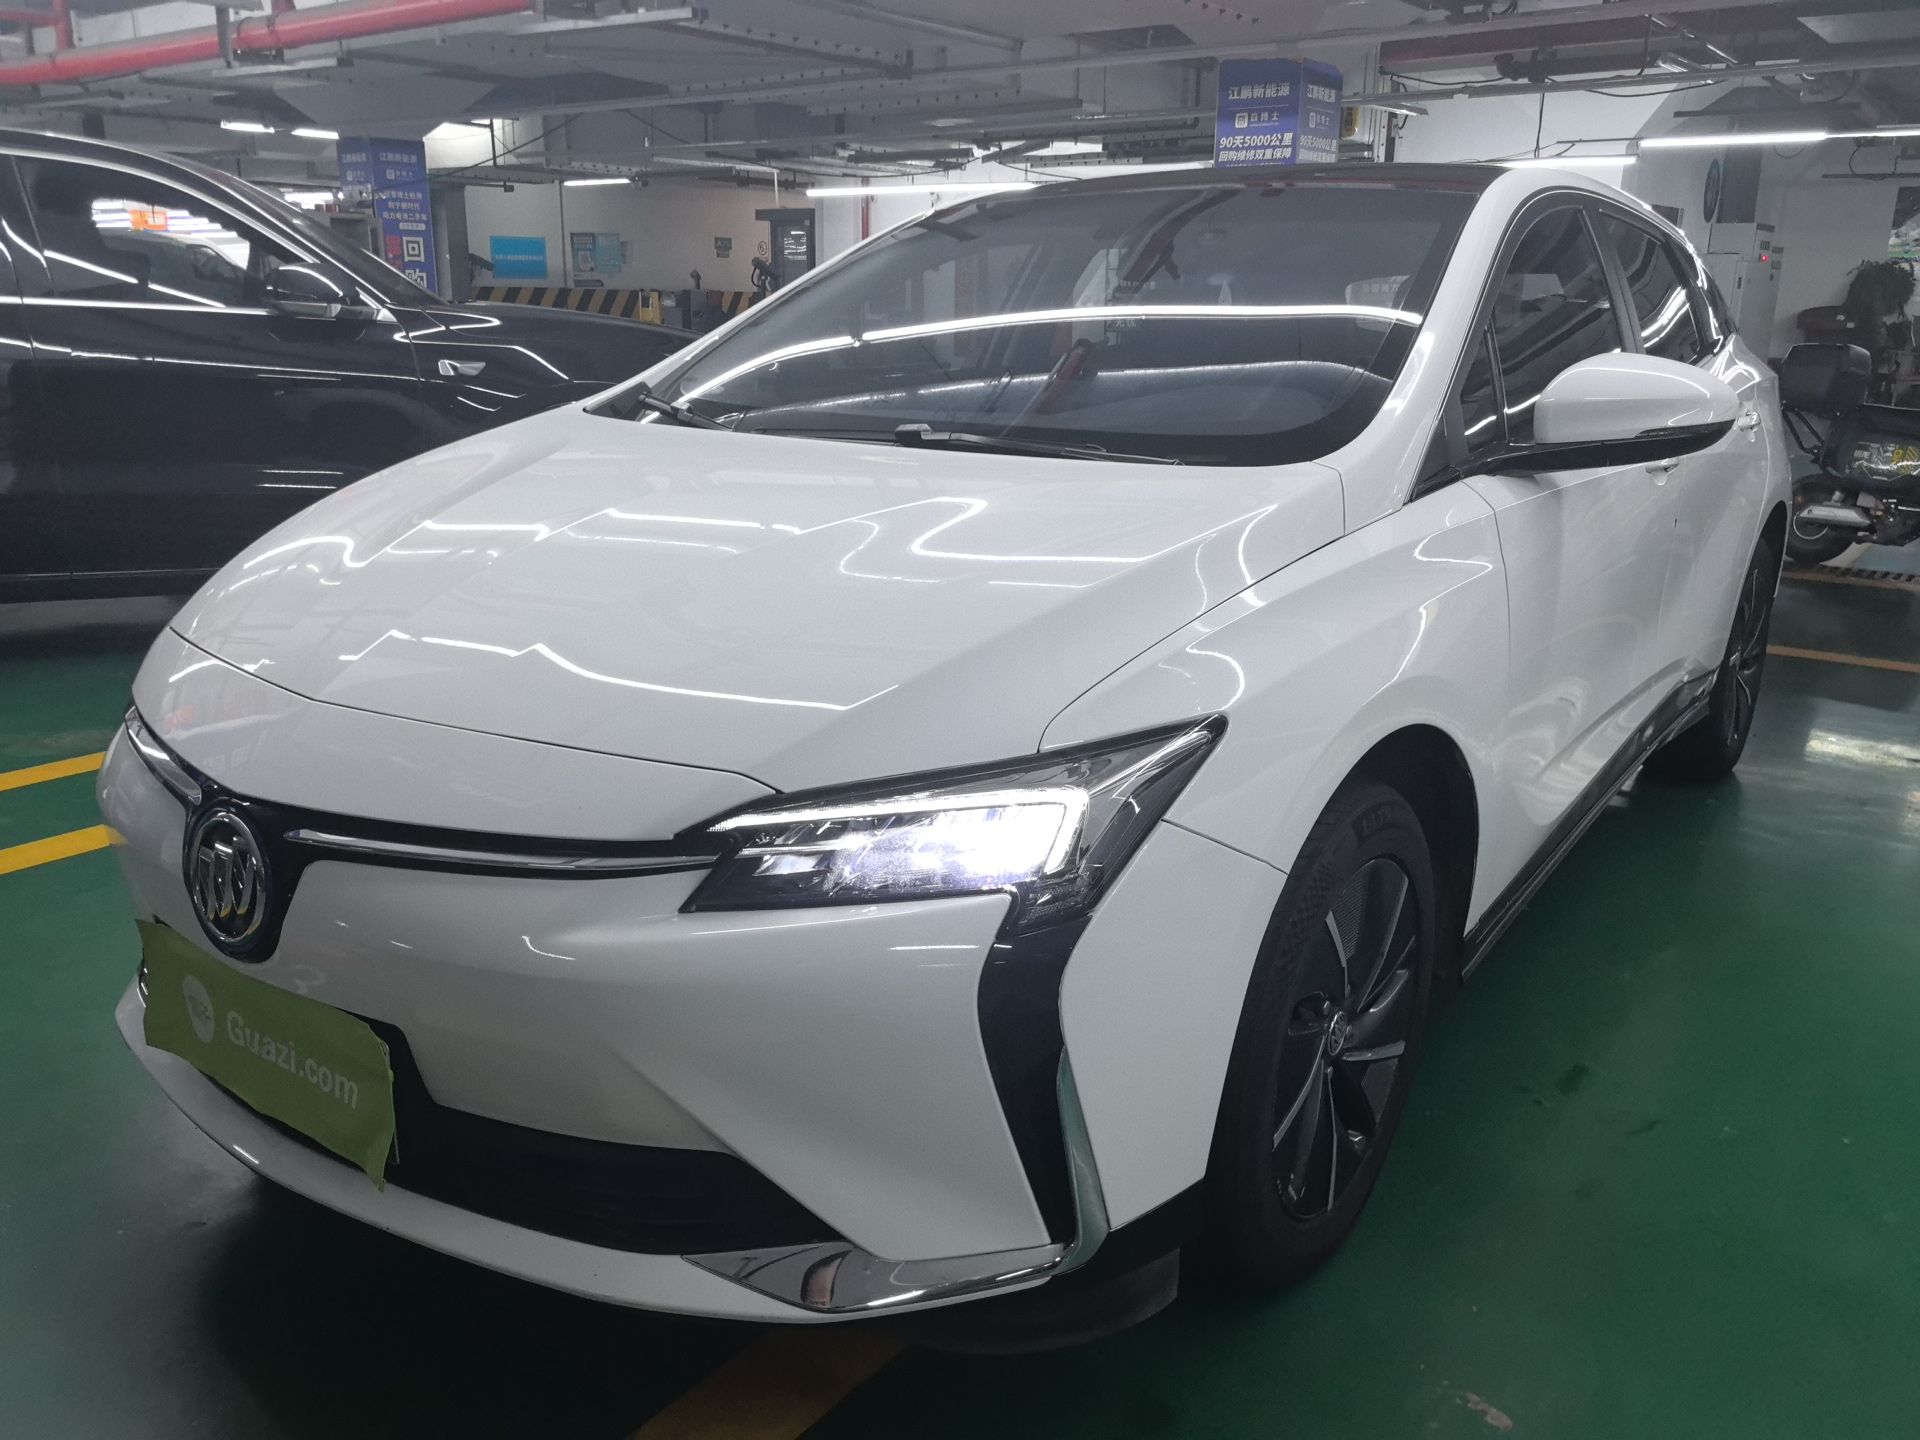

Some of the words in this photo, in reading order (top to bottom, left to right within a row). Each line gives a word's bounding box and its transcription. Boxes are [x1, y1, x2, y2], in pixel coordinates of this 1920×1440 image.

[1220, 132, 1294, 149] 90天5000公里
[1218, 147, 1292, 162] 回购维修双重保障
[226, 1010, 358, 1110] Guazi.com
